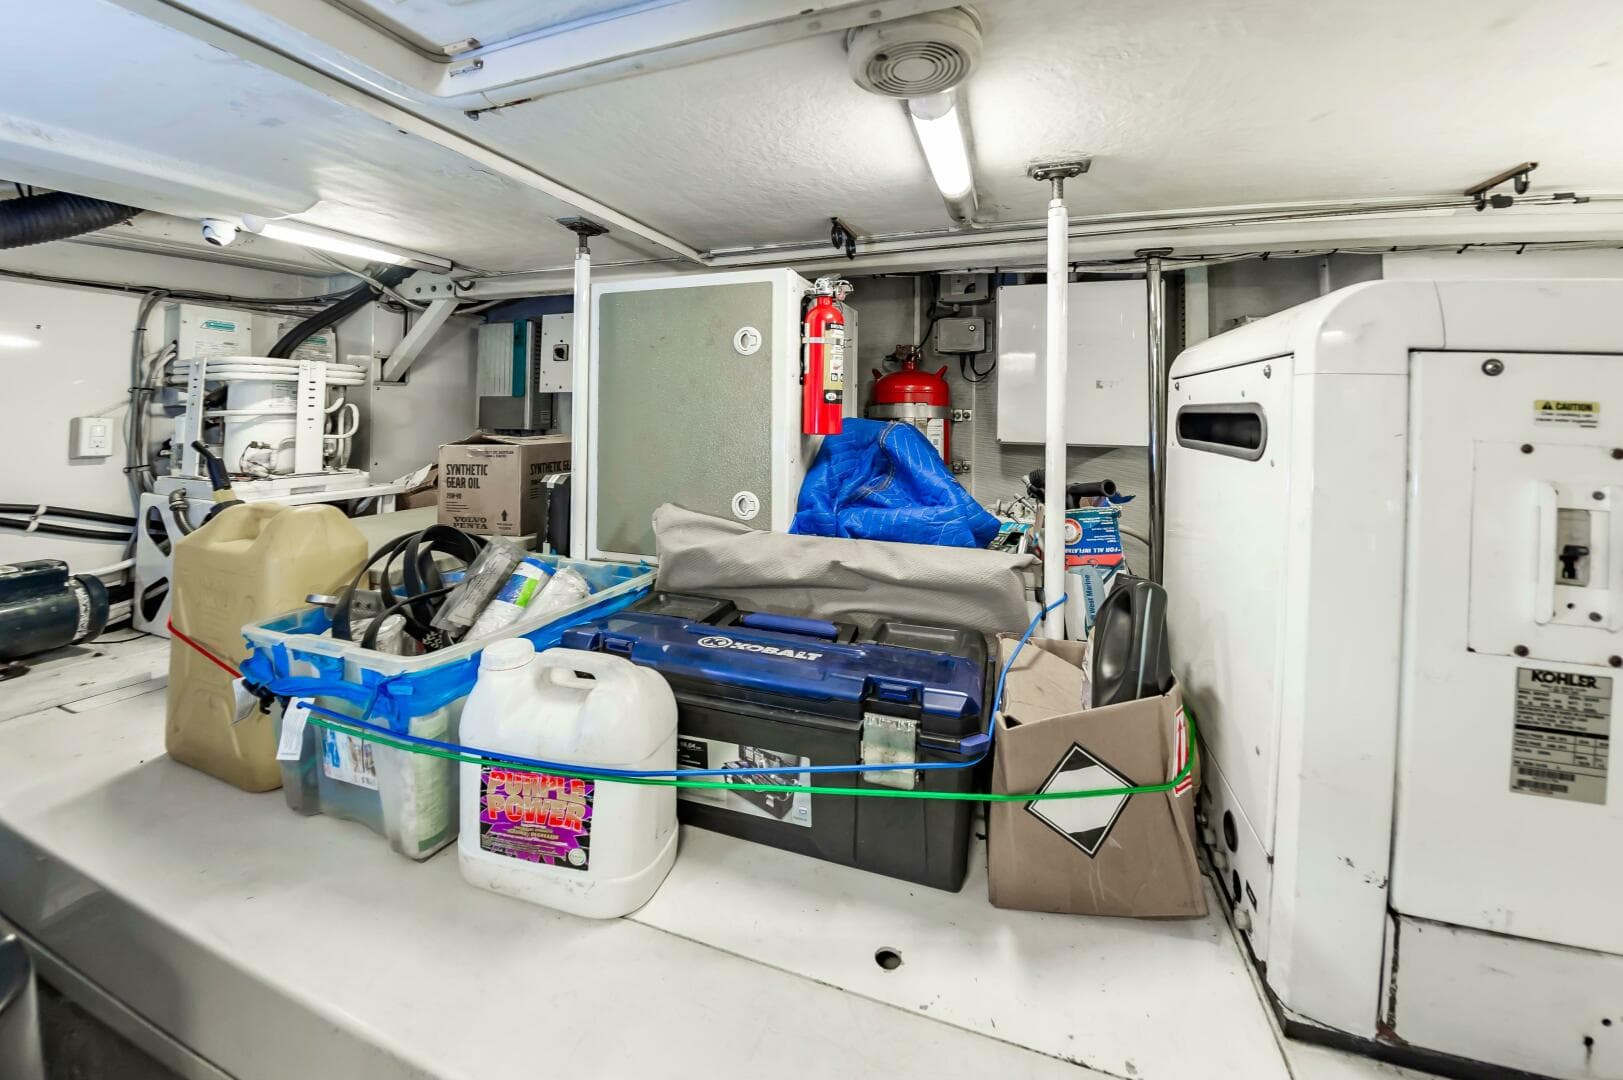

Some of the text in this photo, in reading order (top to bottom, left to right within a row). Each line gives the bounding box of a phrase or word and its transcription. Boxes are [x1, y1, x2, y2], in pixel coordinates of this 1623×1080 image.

[446, 463, 488, 476] SYNTHETIC
[530, 460, 562, 476] SYNTHETIC
[446, 476, 480, 489] GEAR OIL
[453, 522, 489, 530] PENTA
[1084, 575, 1096, 614] West Marine
[730, 642, 822, 661] KOBALT
[1531, 669, 1598, 689] KOHLER
[487, 770, 587, 805] PURPLE
[487, 794, 586, 831] POWER
